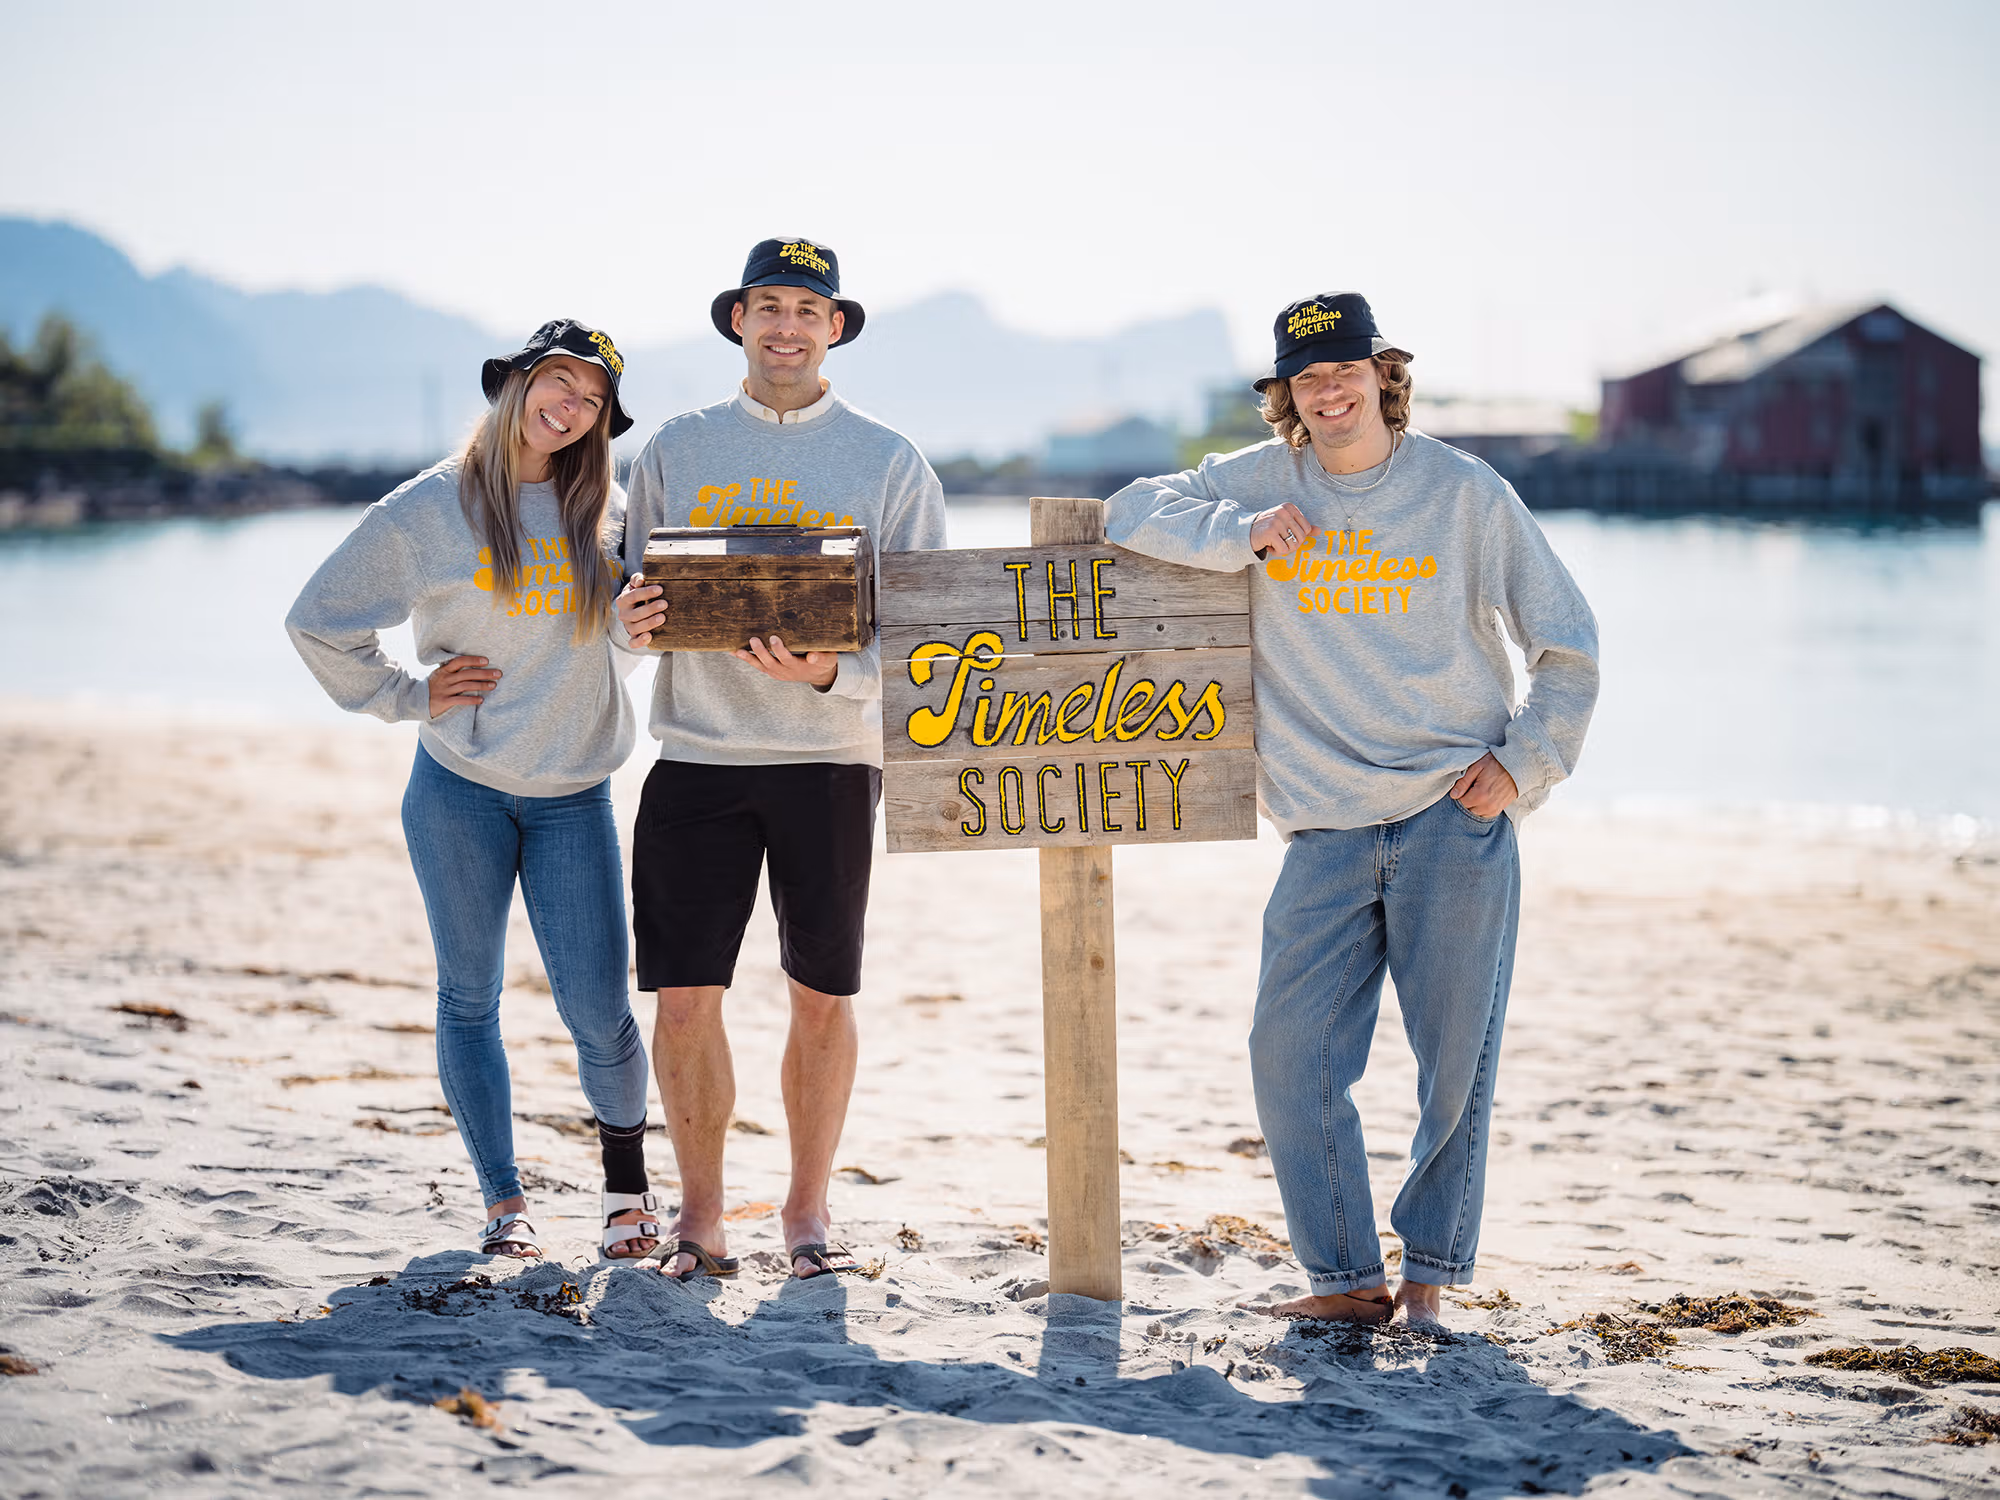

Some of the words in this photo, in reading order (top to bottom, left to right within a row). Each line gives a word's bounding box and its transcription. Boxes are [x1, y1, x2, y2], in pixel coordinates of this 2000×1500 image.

[800, 242, 817, 255] THE
[790, 256, 826, 276] SOCIETY
[1287, 310, 1342, 334] Timeless
[1300, 304, 1319, 317] THE
[1294, 320, 1335, 339] SOCIETY
[749, 477, 799, 505] THE
[1324, 529, 1374, 556] THE
[506, 586, 578, 618] SOCI
[1003, 558, 1118, 642] THE
[1297, 586, 1413, 615] SOCIETY
[905, 630, 1227, 749] Timeless
[958, 758, 1190, 837] SOCIETY
